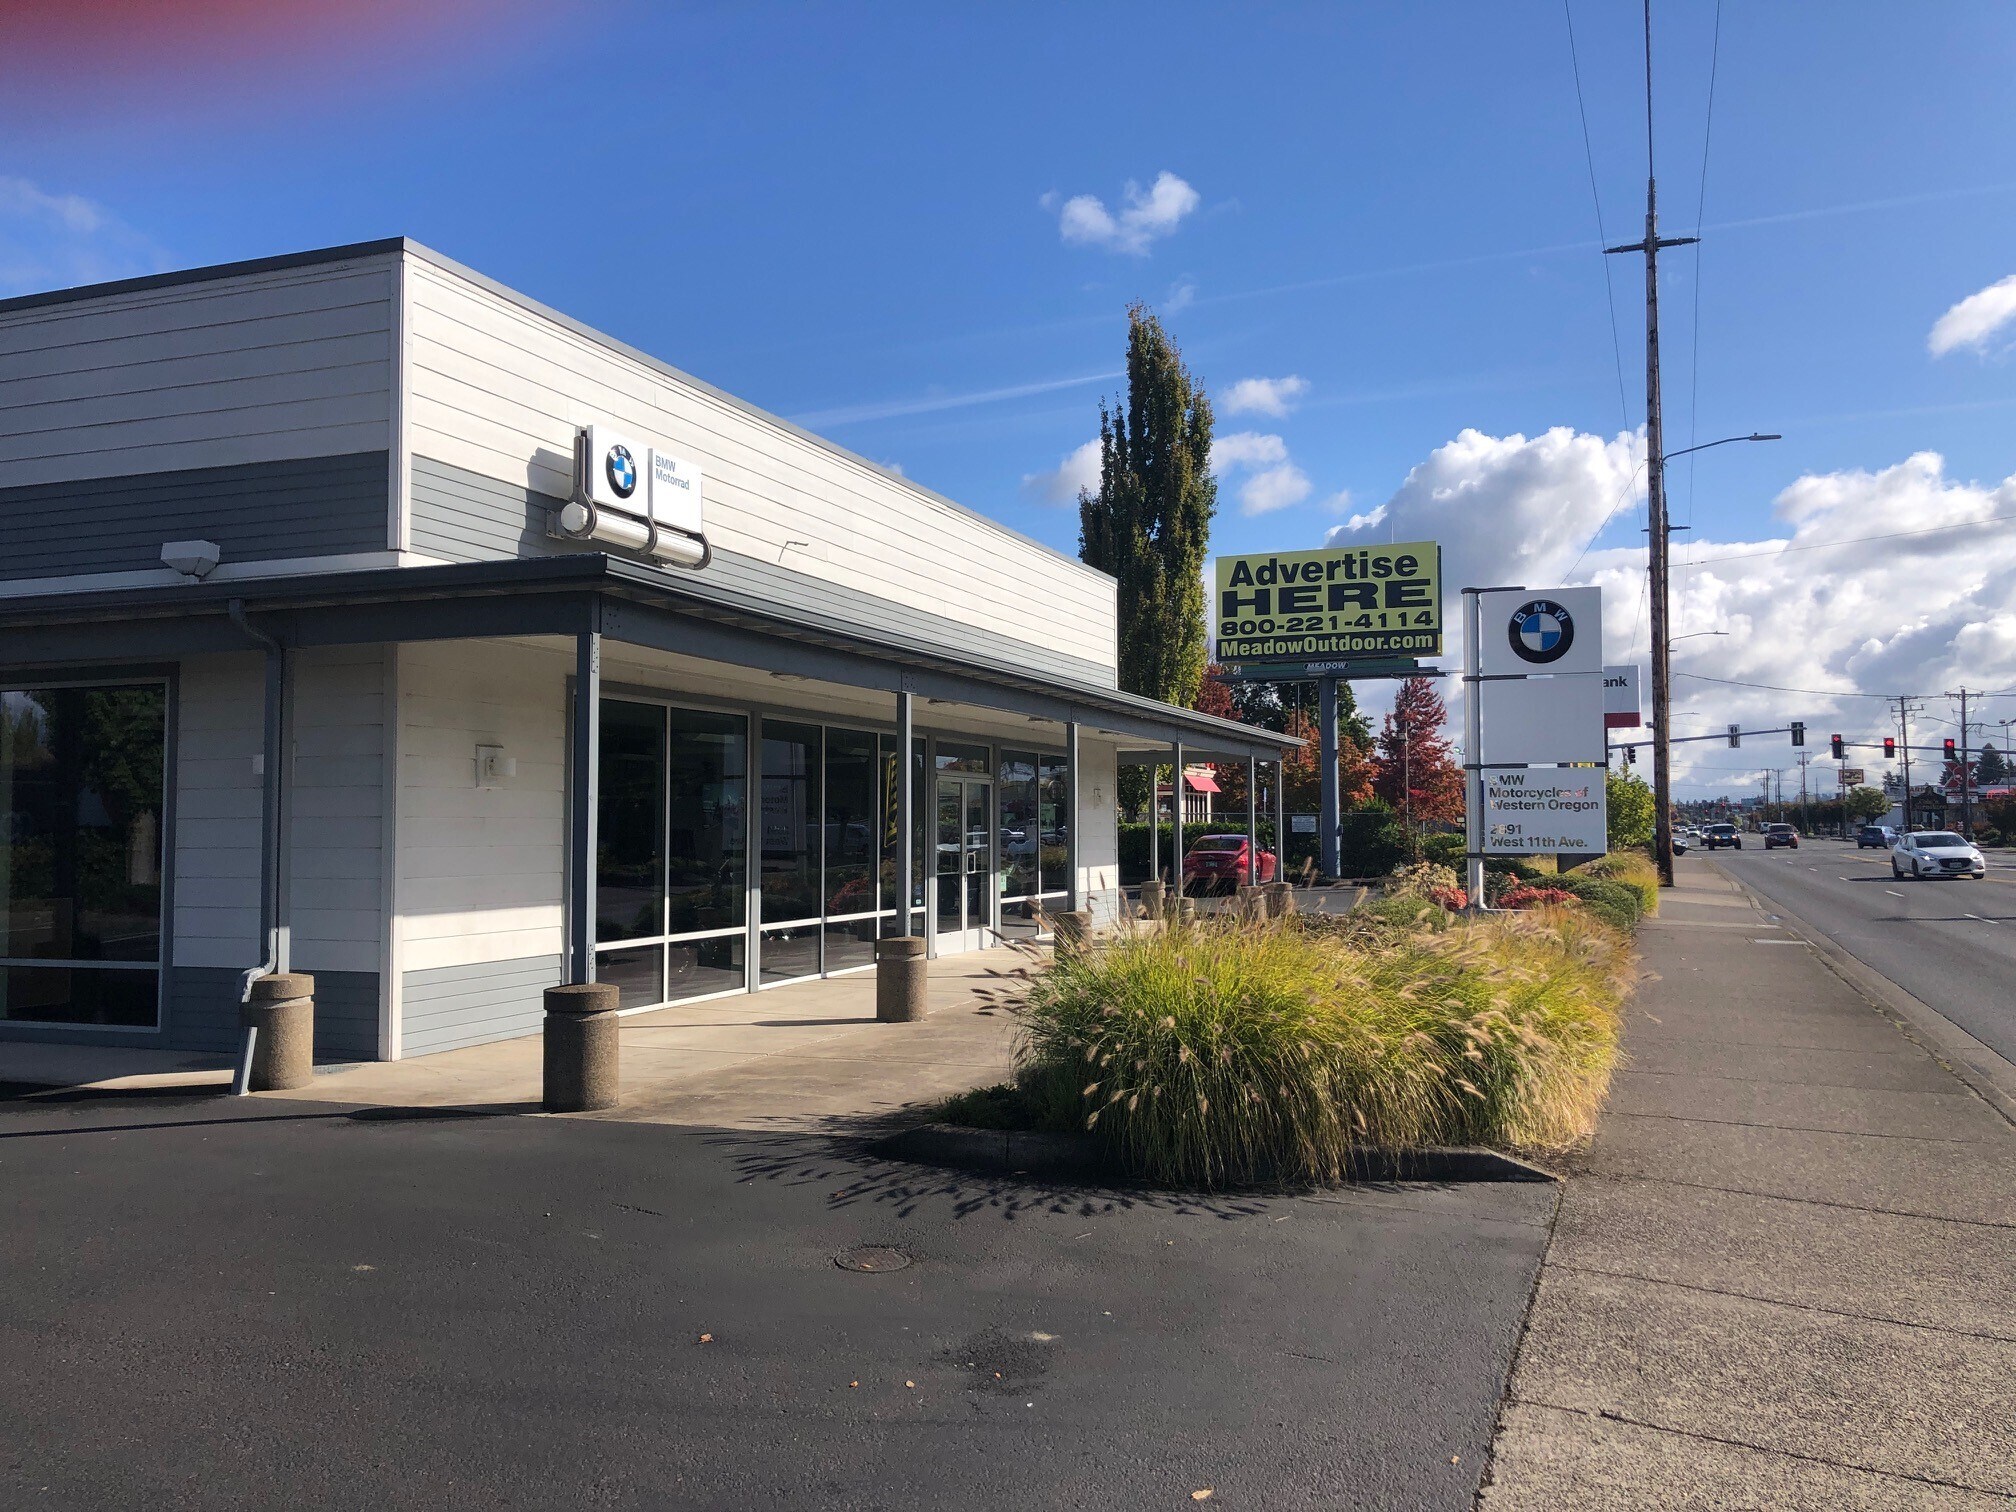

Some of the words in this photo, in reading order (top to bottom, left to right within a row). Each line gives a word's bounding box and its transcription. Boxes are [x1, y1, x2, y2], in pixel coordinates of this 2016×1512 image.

[655, 455, 676, 472] BMW
[655, 468, 690, 490] Motorrad
[1229, 550, 1419, 587] Advertise
[1222, 578, 1433, 618] HERE
[1221, 611, 1433, 636] 800-221-4114
[1513, 603, 1569, 625] BMW
[1221, 633, 1433, 657] MeadowOutdoor.com
[1603, 676, 1628, 688] ank
[1489, 787, 1572, 800] Motorcycles
[1490, 800, 1545, 811] Western
[1548, 799, 1599, 812] Oregon
[1490, 836, 1524, 847] West
[1527, 836, 1555, 847] 11th
[1558, 836, 1588, 847] Ave.
